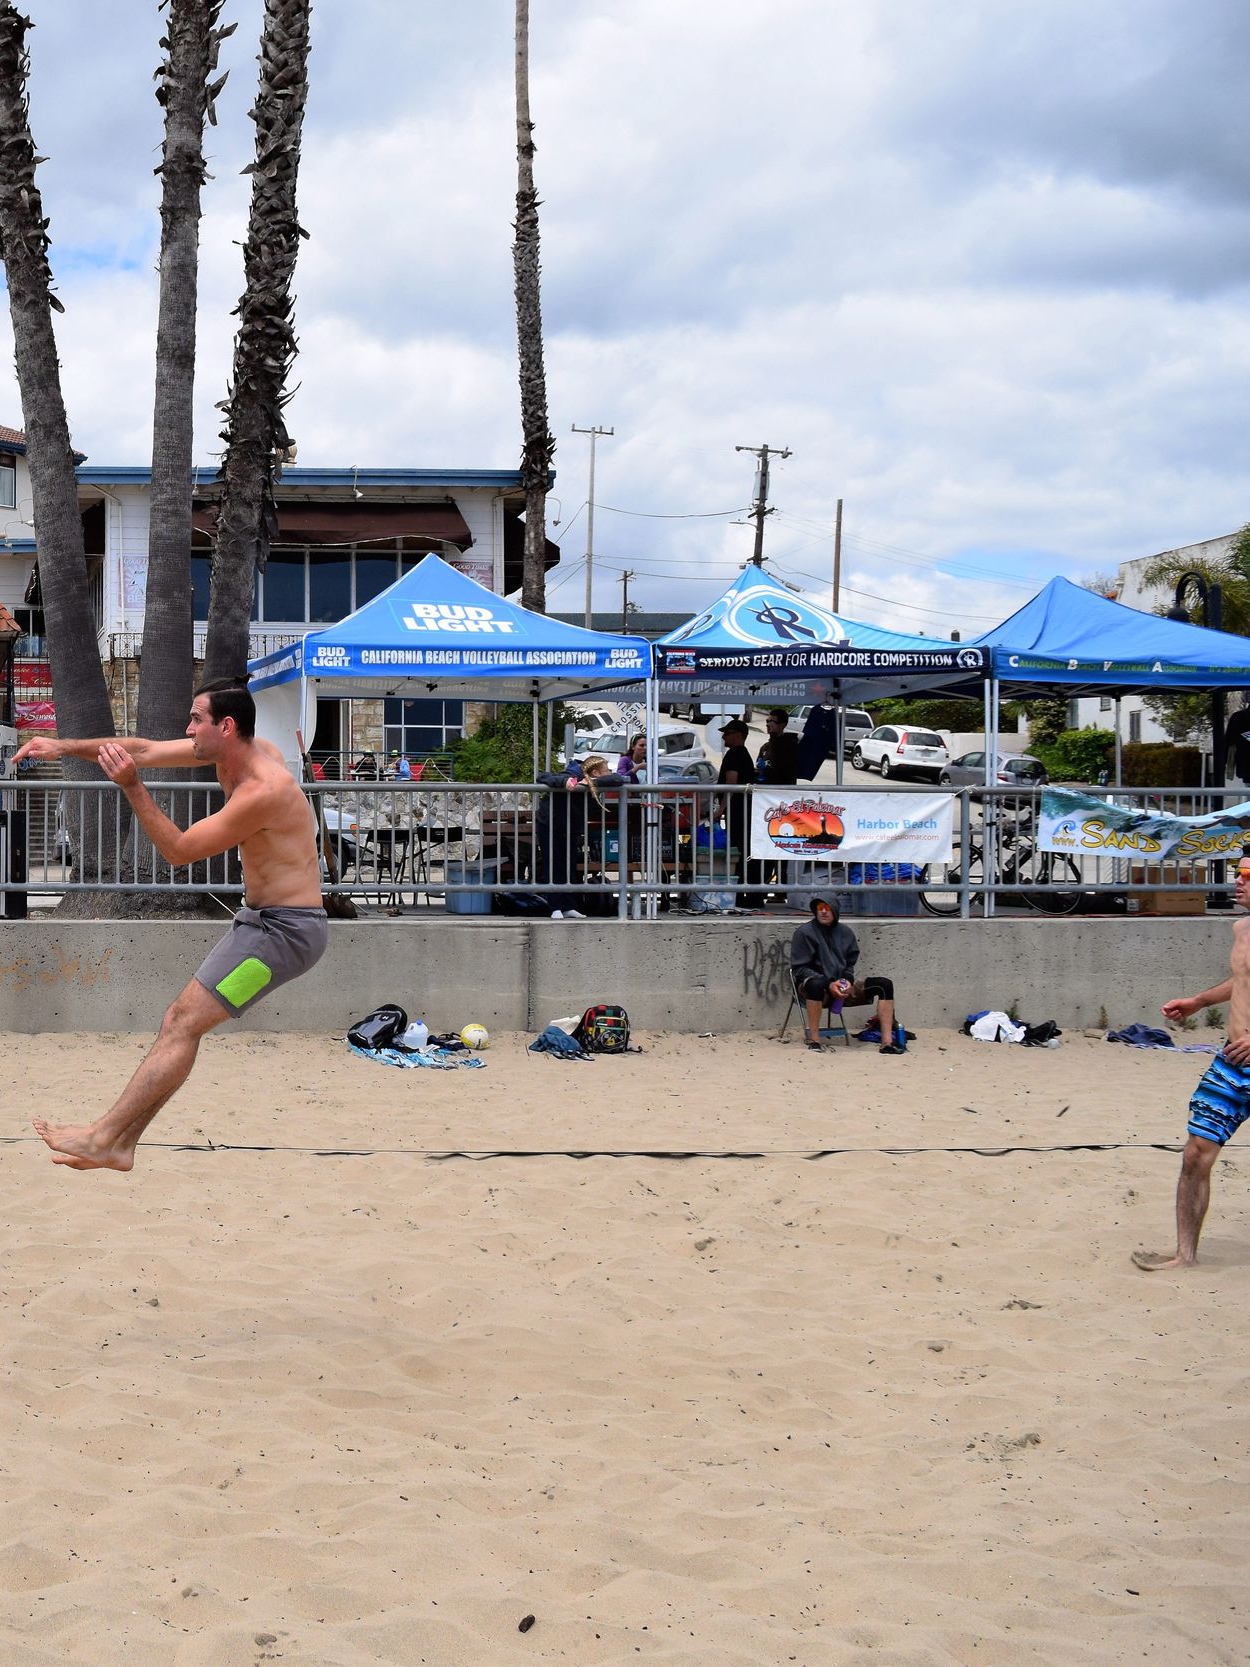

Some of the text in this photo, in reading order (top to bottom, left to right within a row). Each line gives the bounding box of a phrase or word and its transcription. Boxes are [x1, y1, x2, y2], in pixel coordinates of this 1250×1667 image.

[412, 603, 493, 621] BUD
[403, 617, 513, 633] LIGHT
[318, 646, 346, 657] BUD
[361, 650, 596, 665] CALIFORNIA BEACH VOLLEYBALL ASSOCIATION
[610, 649, 639, 659] BUD
[312, 656, 351, 667] LIGHT
[605, 658, 643, 669] LIGHT
[700, 655, 750, 668] SERIOUS
[752, 655, 783, 667] GEAR
[785, 653, 807, 666] FOR
[810, 652, 870, 666] HARDCORE
[873, 652, 953, 666] COMPETITION
[857, 819, 938, 830] Harbor Beach
[1081, 820, 1161, 853] SAND
